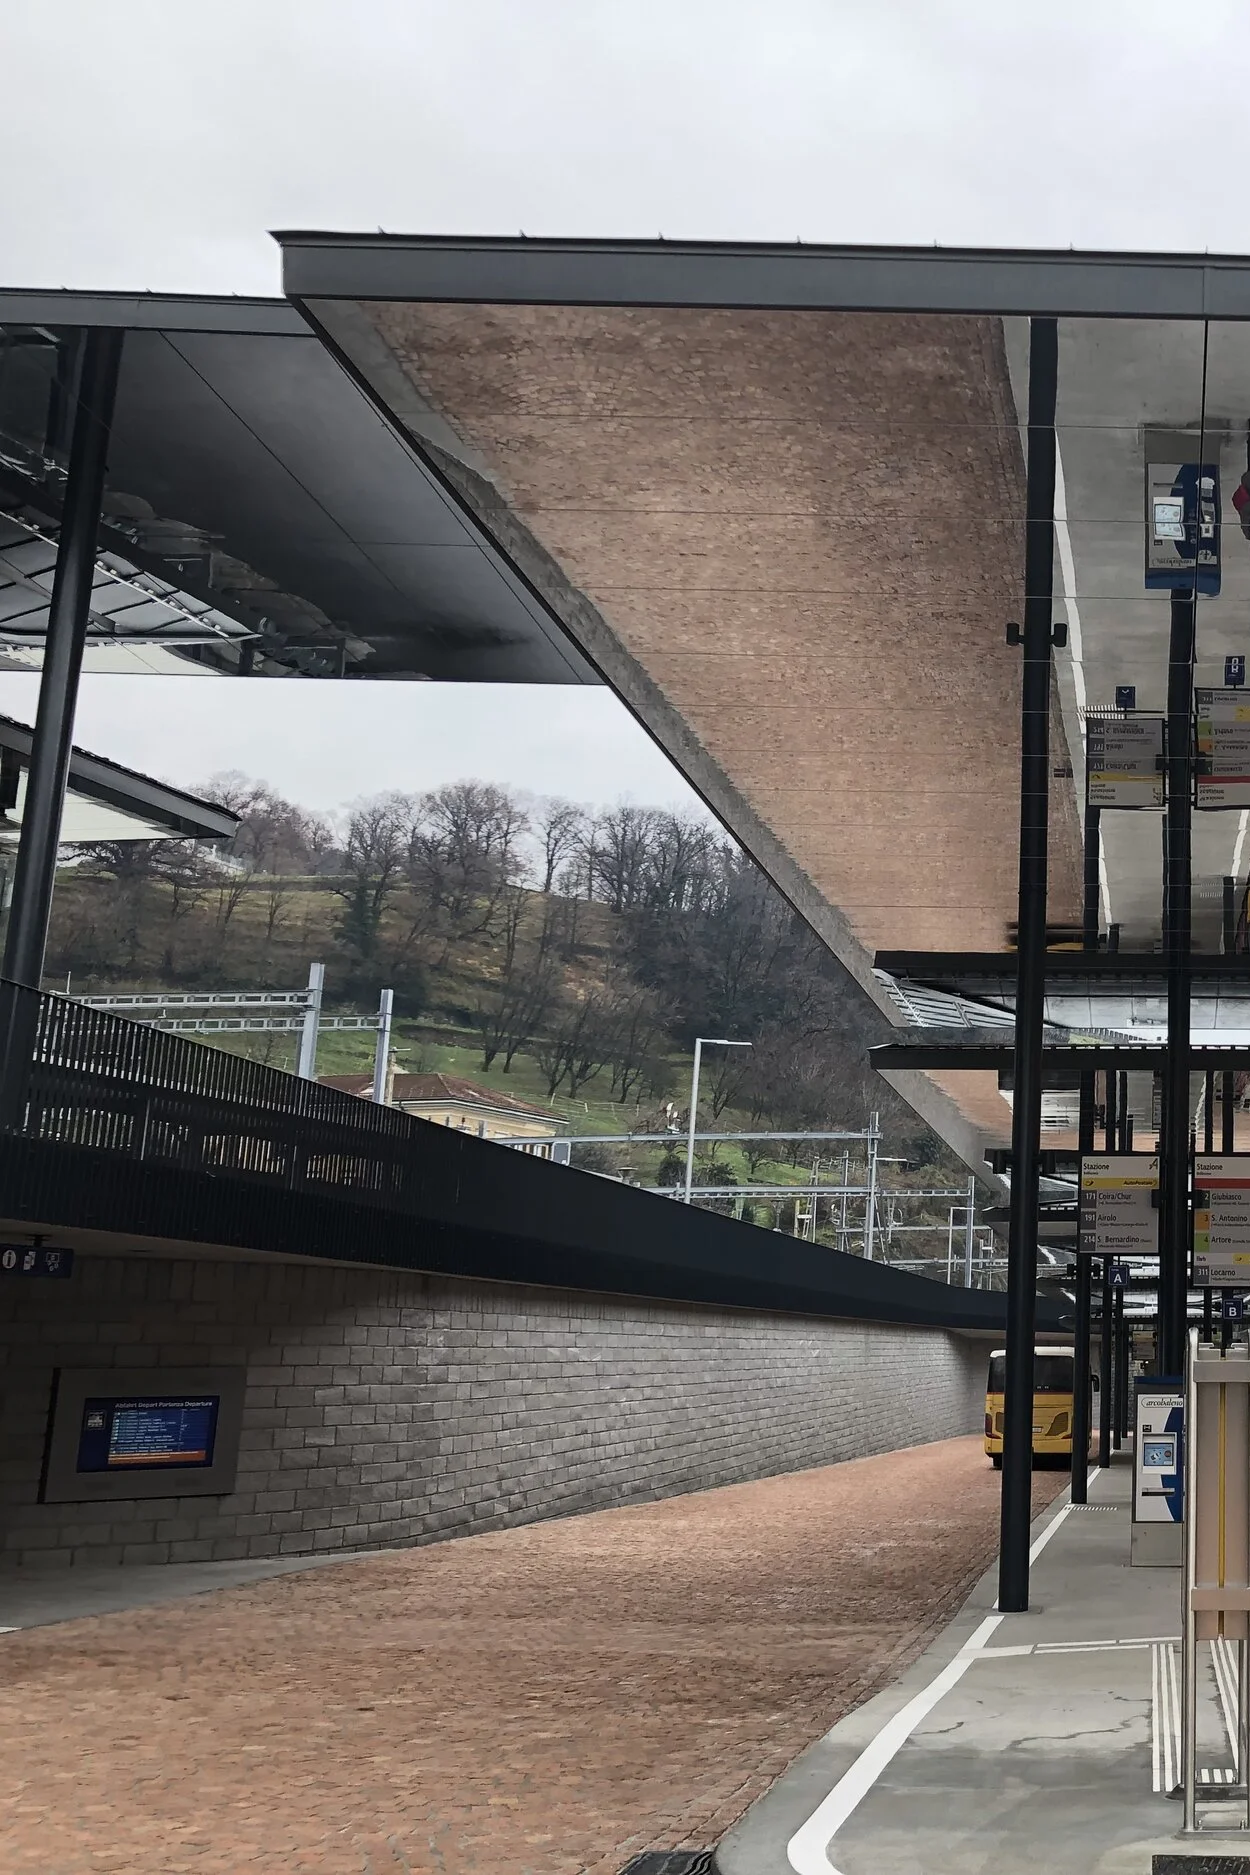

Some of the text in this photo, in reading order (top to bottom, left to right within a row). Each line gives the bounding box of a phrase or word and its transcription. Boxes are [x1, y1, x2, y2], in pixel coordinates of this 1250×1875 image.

[1196, 1163, 1223, 1171] Stazione
[1098, 1192, 1132, 1200] Coira/Chur
[1211, 1192, 1242, 1200] Giubiasco
[1204, 1214, 1209, 1222] 3
[1218, 1214, 1248, 1222] Antonino
[1104, 1235, 1140, 1243] Bernardino
[1211, 1236, 1232, 1244] Artore
[1113, 1273, 1122, 1283] A
[1229, 1307, 1237, 1317] B
